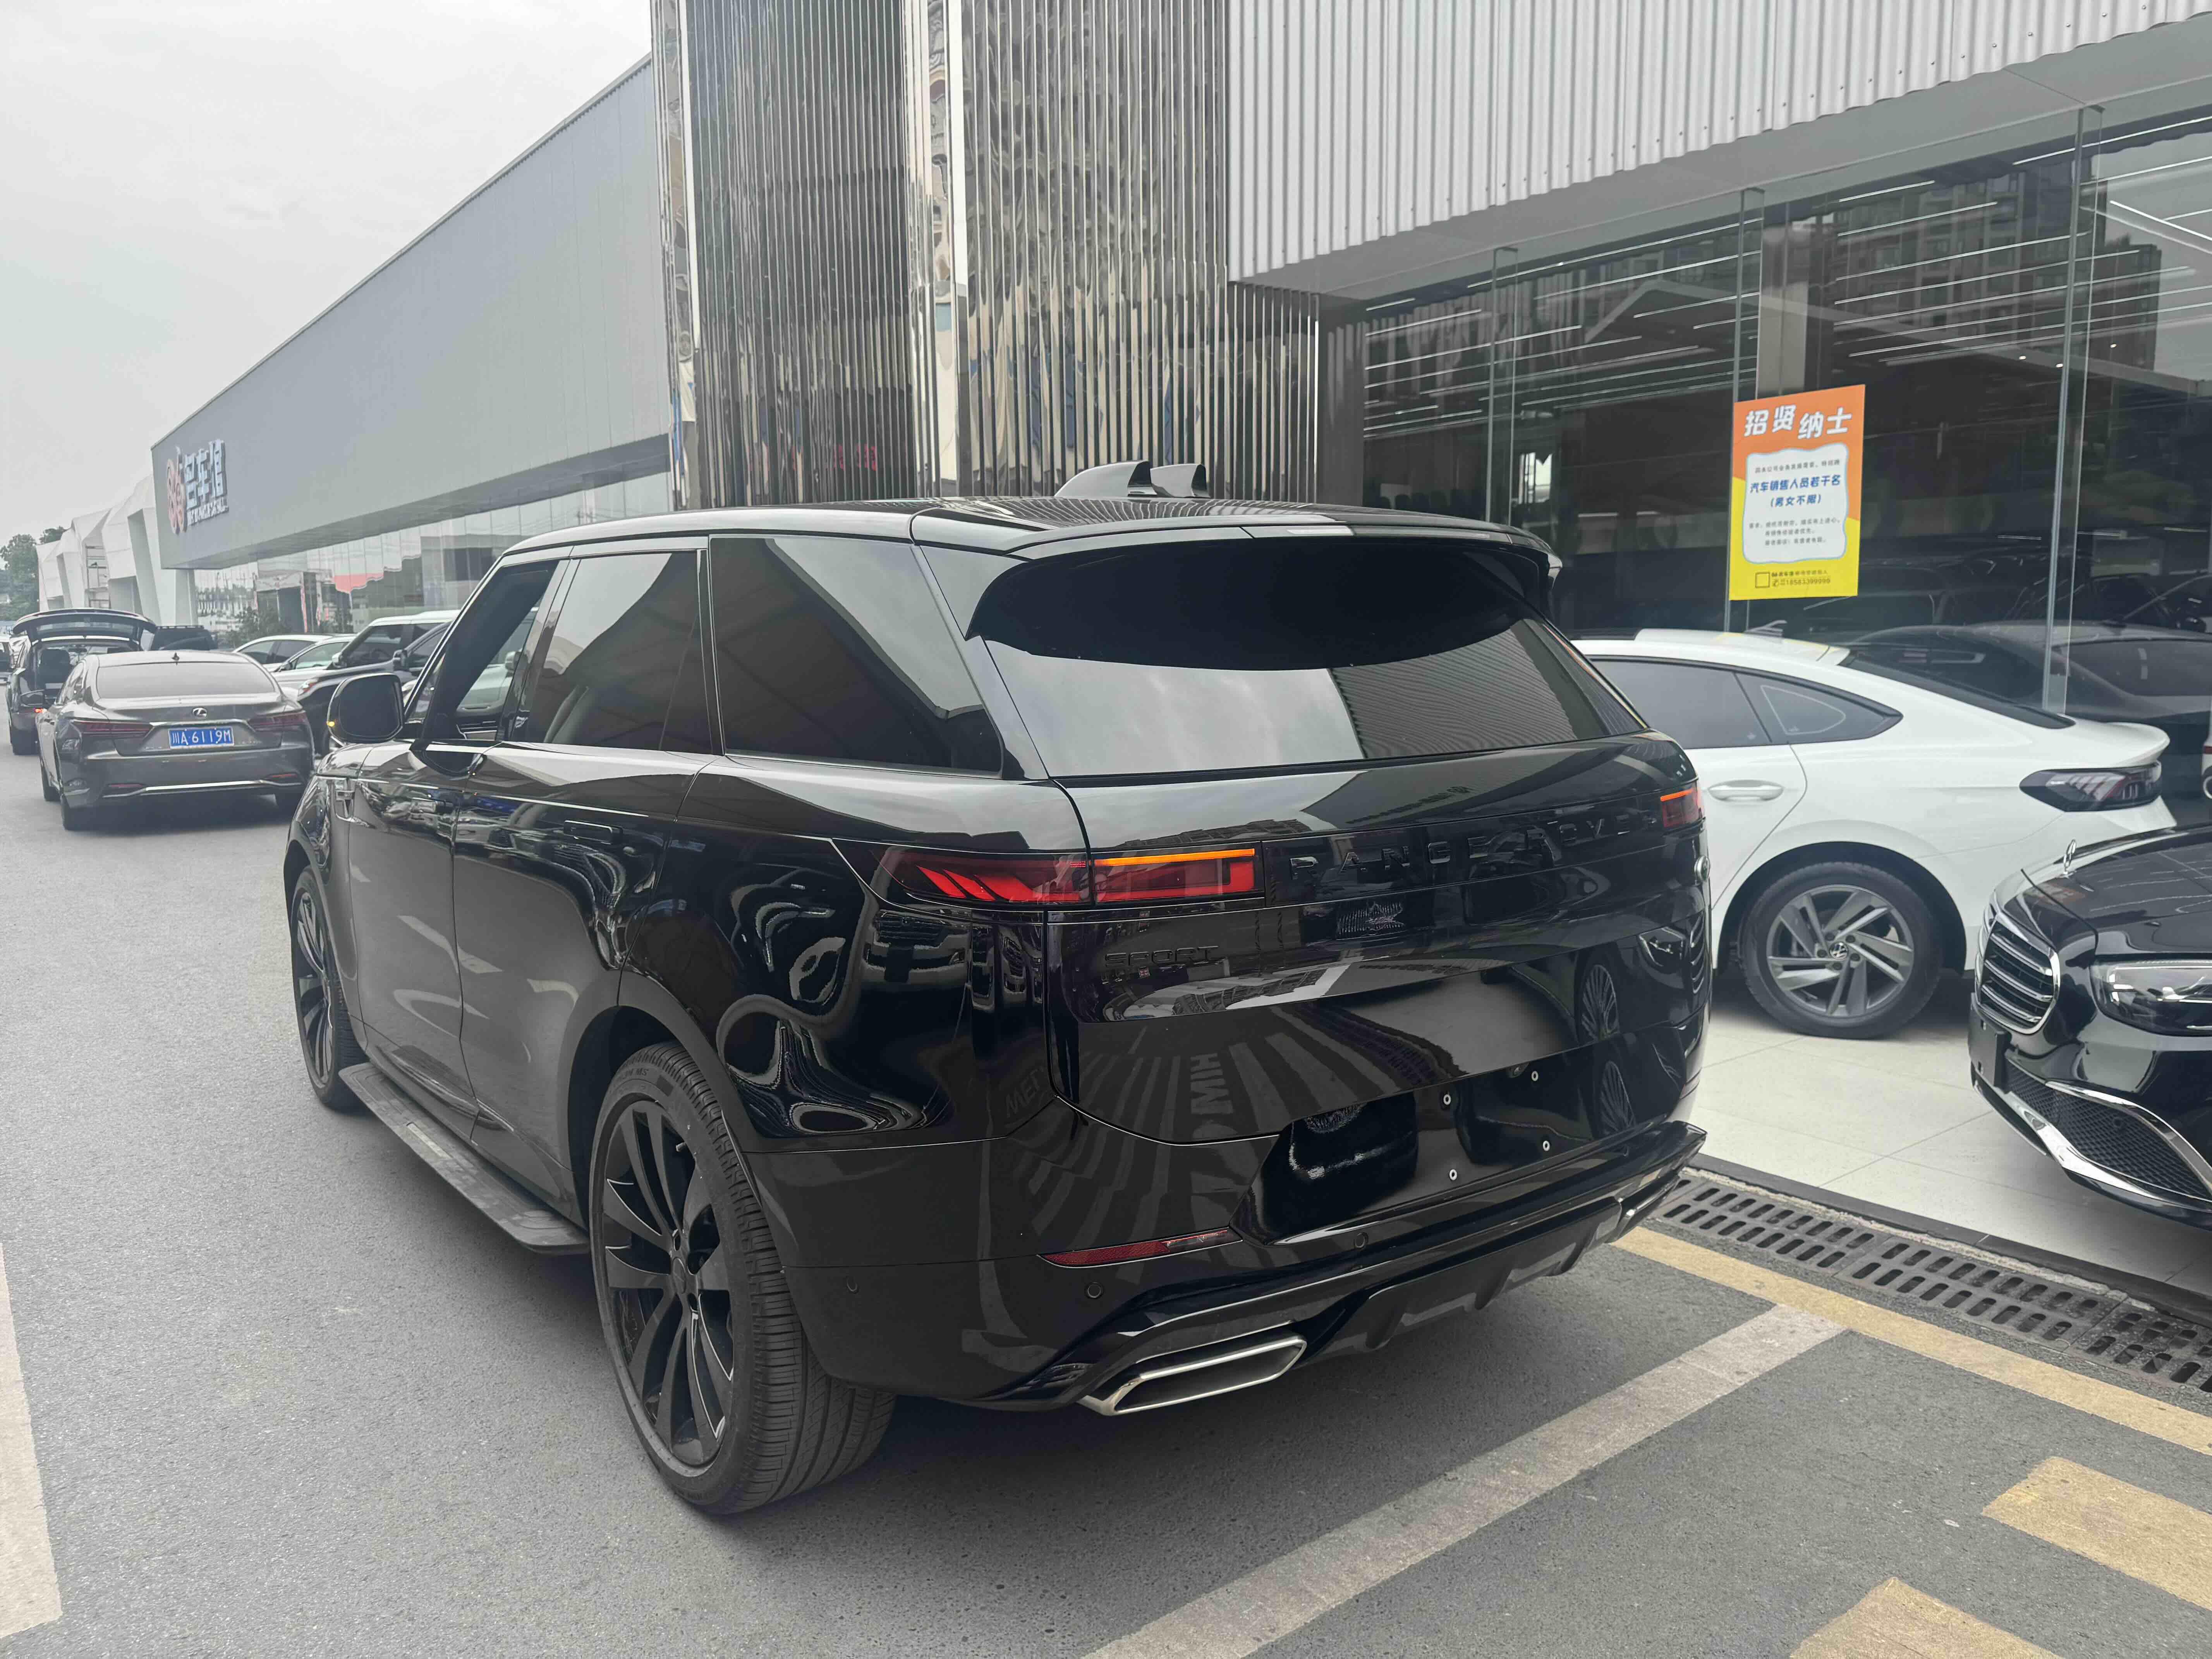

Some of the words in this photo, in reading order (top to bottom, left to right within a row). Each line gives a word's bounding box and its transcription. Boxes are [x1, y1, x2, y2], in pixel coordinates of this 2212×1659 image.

[1744, 404, 1852, 439] 招贤纳士
[1750, 474, 1841, 493] 汽车销售人员若干名
[1289, 836, 1488, 881] RANGE
[1105, 945, 1219, 967] SPORT
